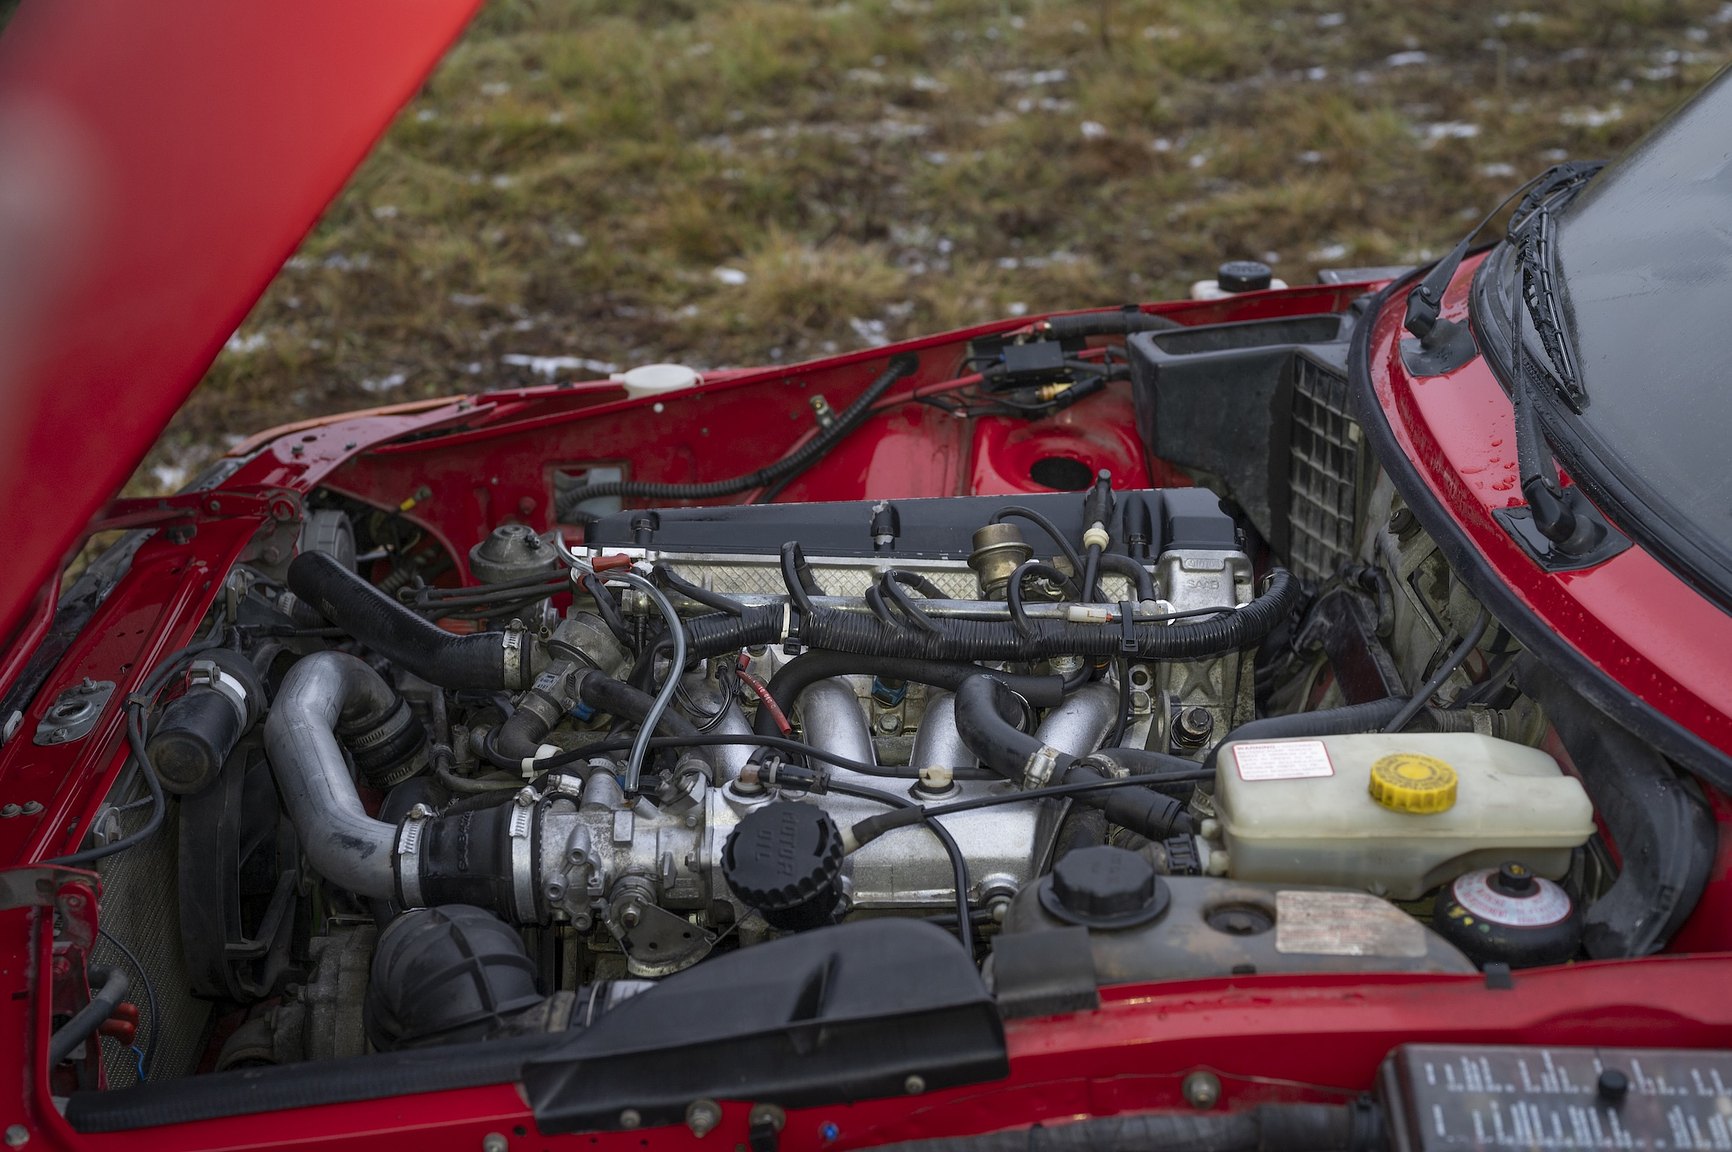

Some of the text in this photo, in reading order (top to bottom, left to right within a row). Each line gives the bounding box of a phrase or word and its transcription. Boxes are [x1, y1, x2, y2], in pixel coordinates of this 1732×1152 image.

[1187, 578, 1220, 590] SAAB
[754, 829, 773, 863] OIL
[777, 811, 800, 877] MOTOR
